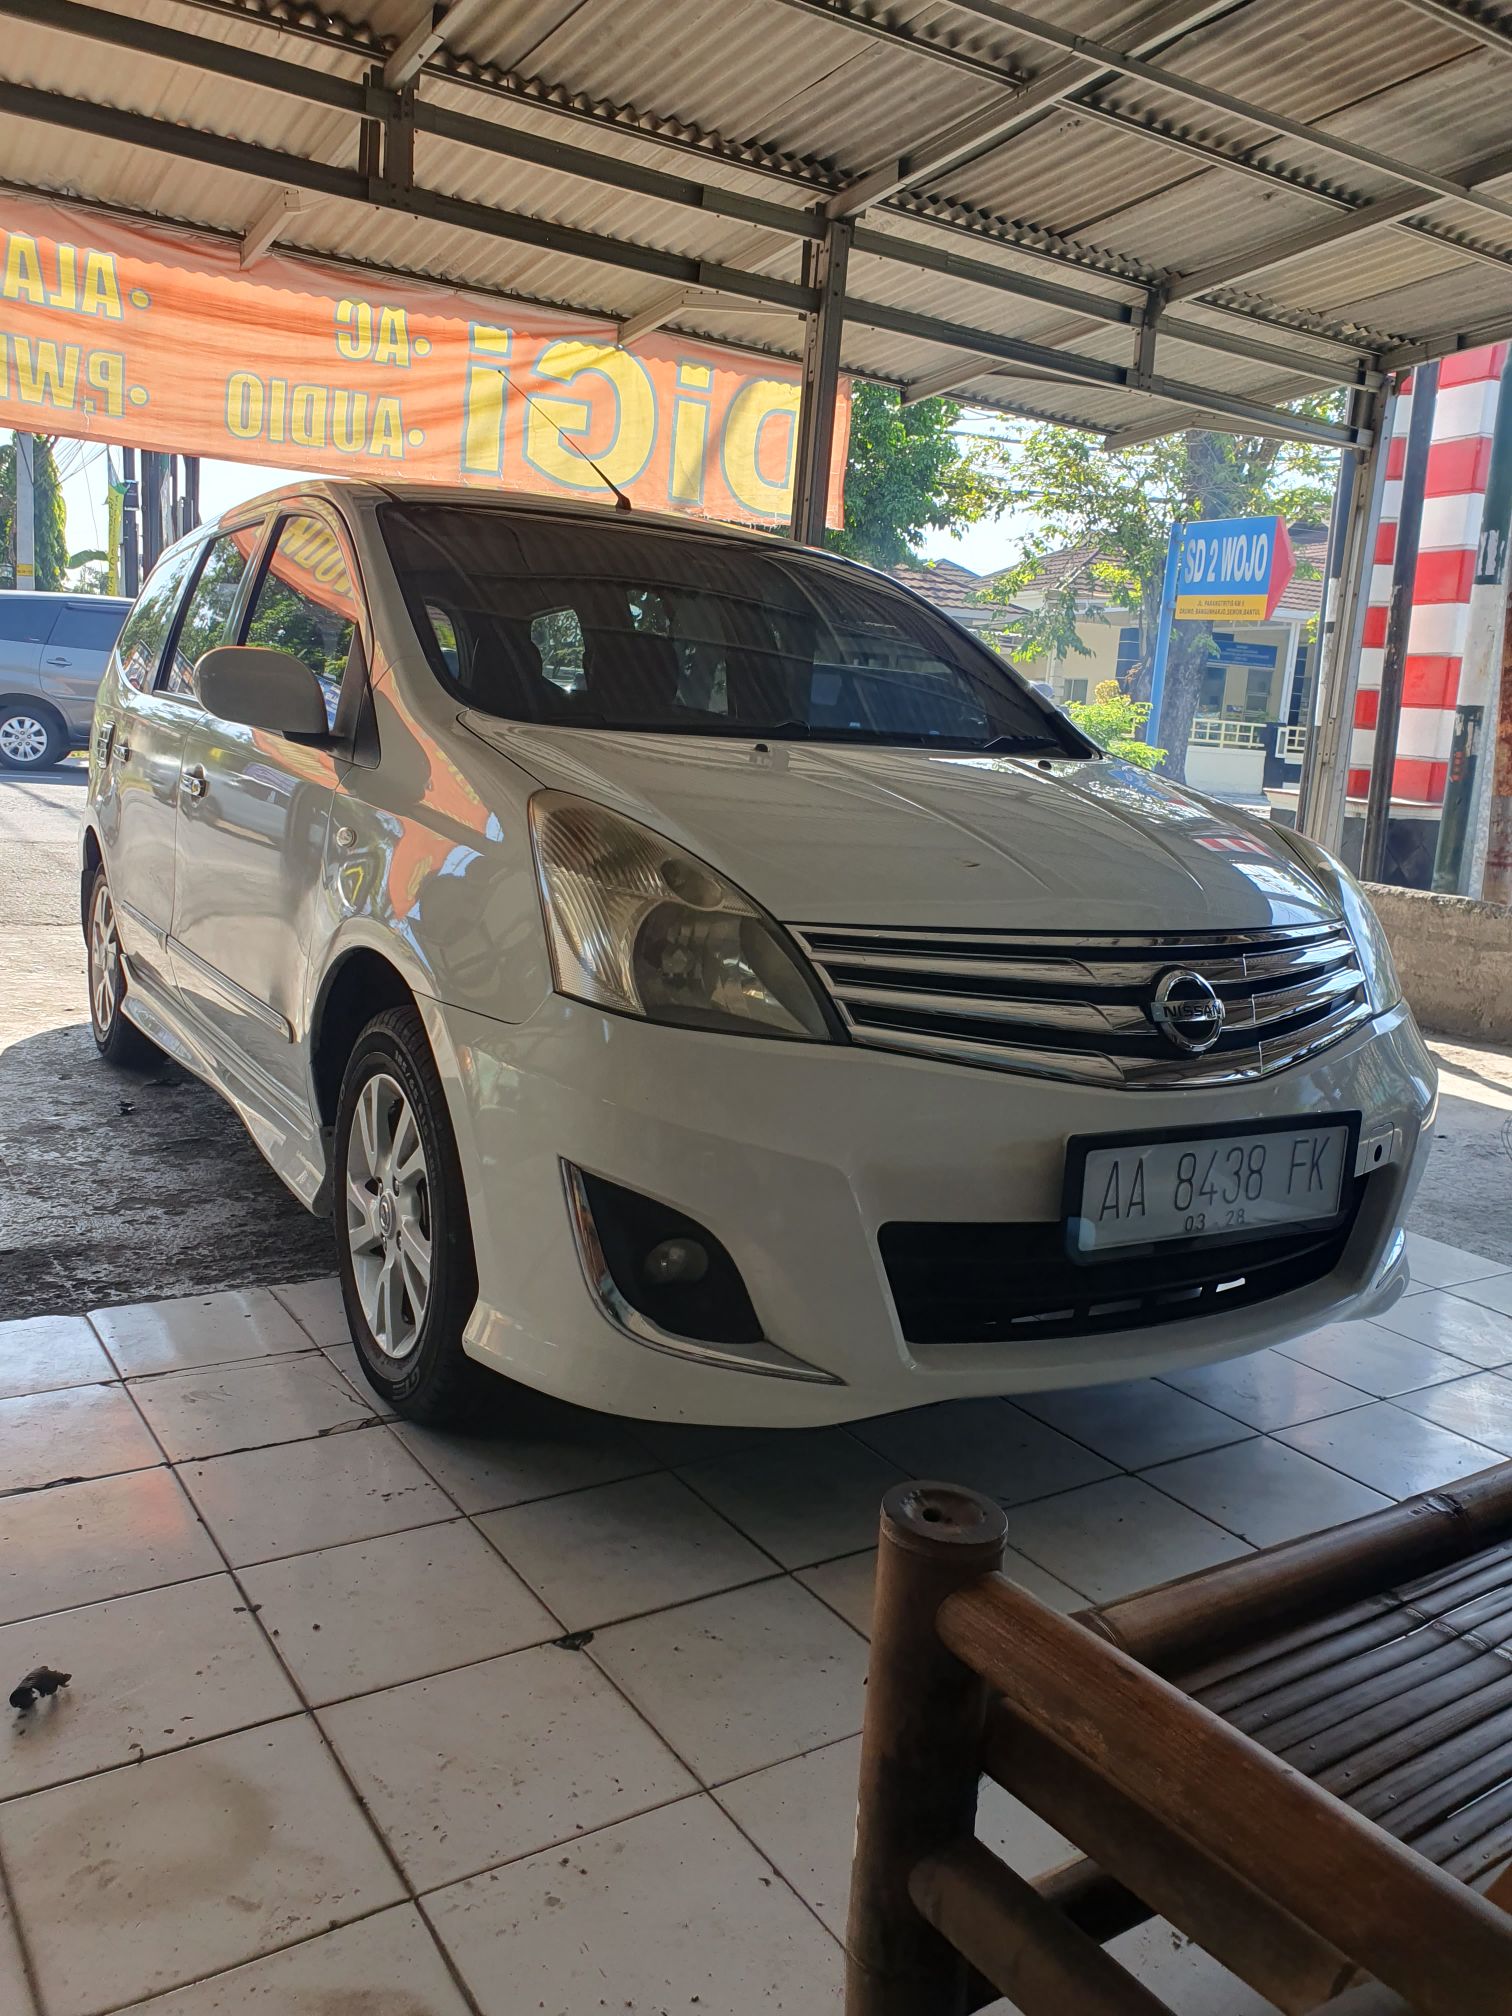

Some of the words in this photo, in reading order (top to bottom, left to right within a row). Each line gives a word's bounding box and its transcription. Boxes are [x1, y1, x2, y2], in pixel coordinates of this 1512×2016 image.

[1184, 538, 1206, 584] SD
[1206, 538, 1219, 583] 2
[1220, 533, 1268, 582] WOJO
[1163, 1001, 1222, 1019] NISSAN
[1099, 1157, 1147, 1221] AA
[1174, 1144, 1267, 1212] 8438
[1287, 1137, 1331, 1195] FK
[1185, 1213, 1206, 1231] 03
[1225, 1208, 1245, 1225] 28
